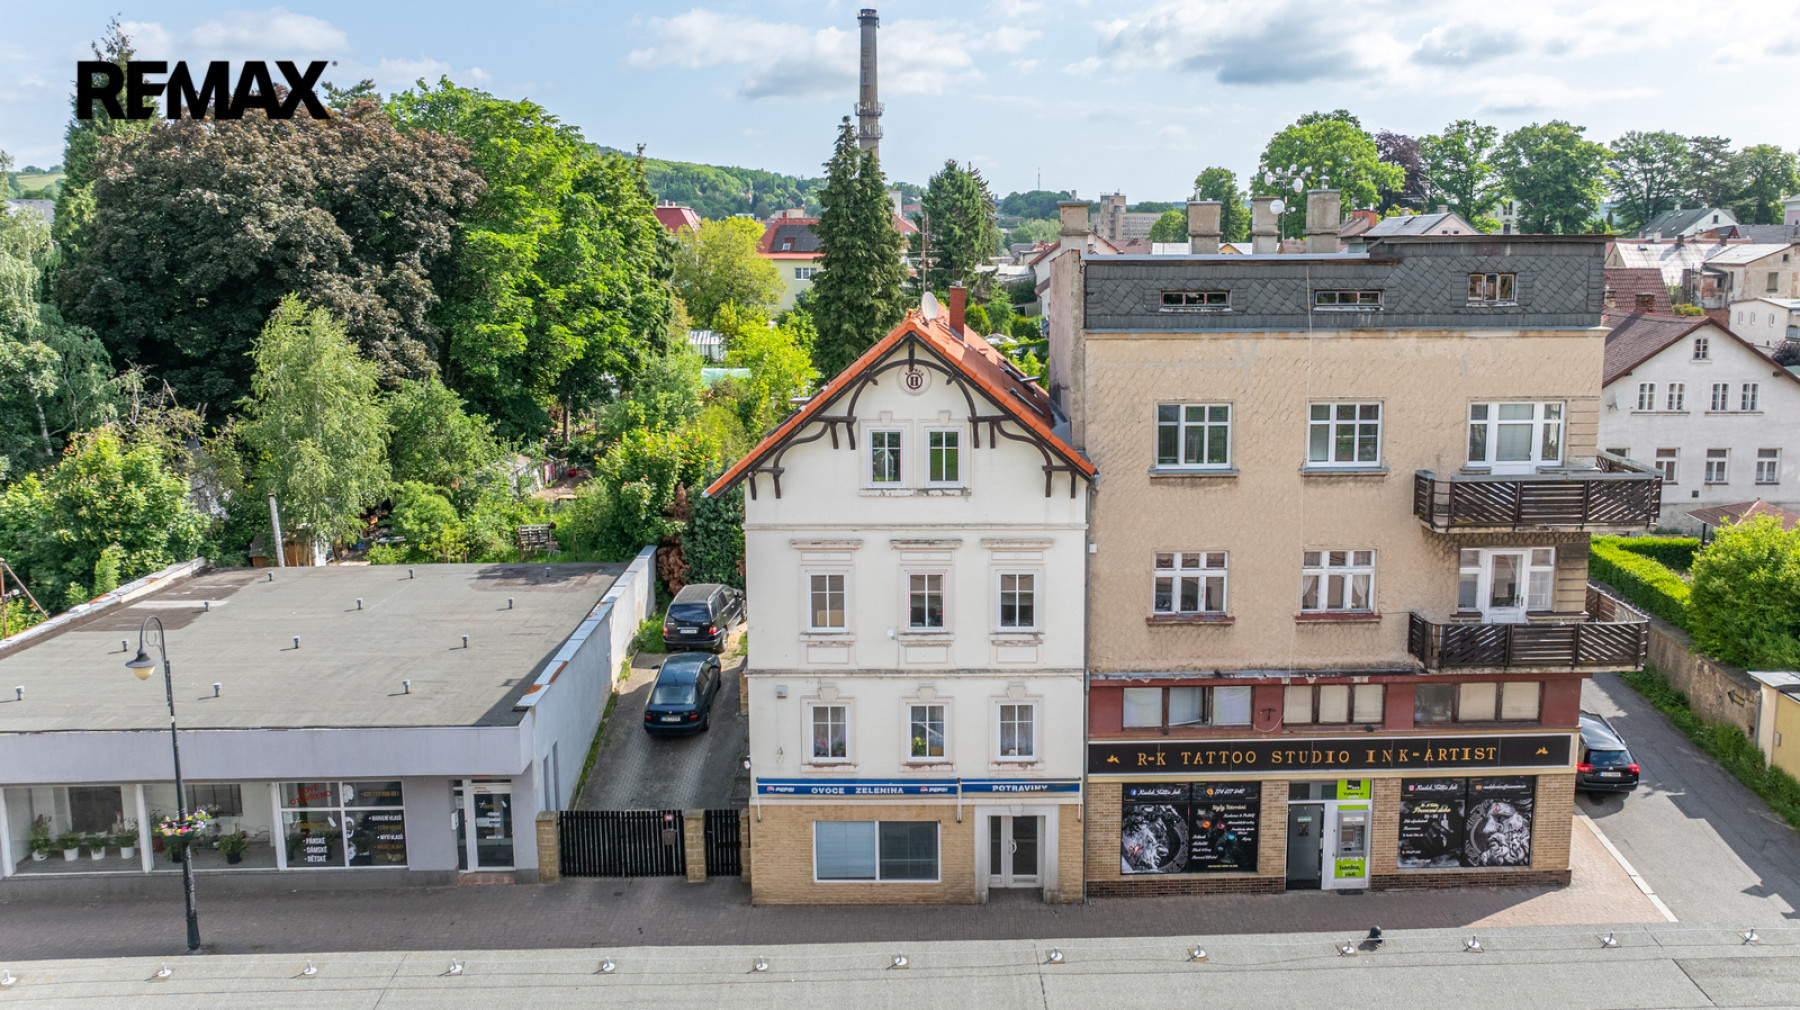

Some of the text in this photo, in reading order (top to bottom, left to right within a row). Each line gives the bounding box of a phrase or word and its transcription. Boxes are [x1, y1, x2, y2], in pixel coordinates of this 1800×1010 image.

[1137, 752, 1166, 766] R-K
[1180, 750, 1257, 765] TATTOO
[1271, 749, 1350, 764] STUDIO
[811, 786, 904, 795] OVOCE ZELENINA
[992, 784, 1048, 792] POTRAVINY
